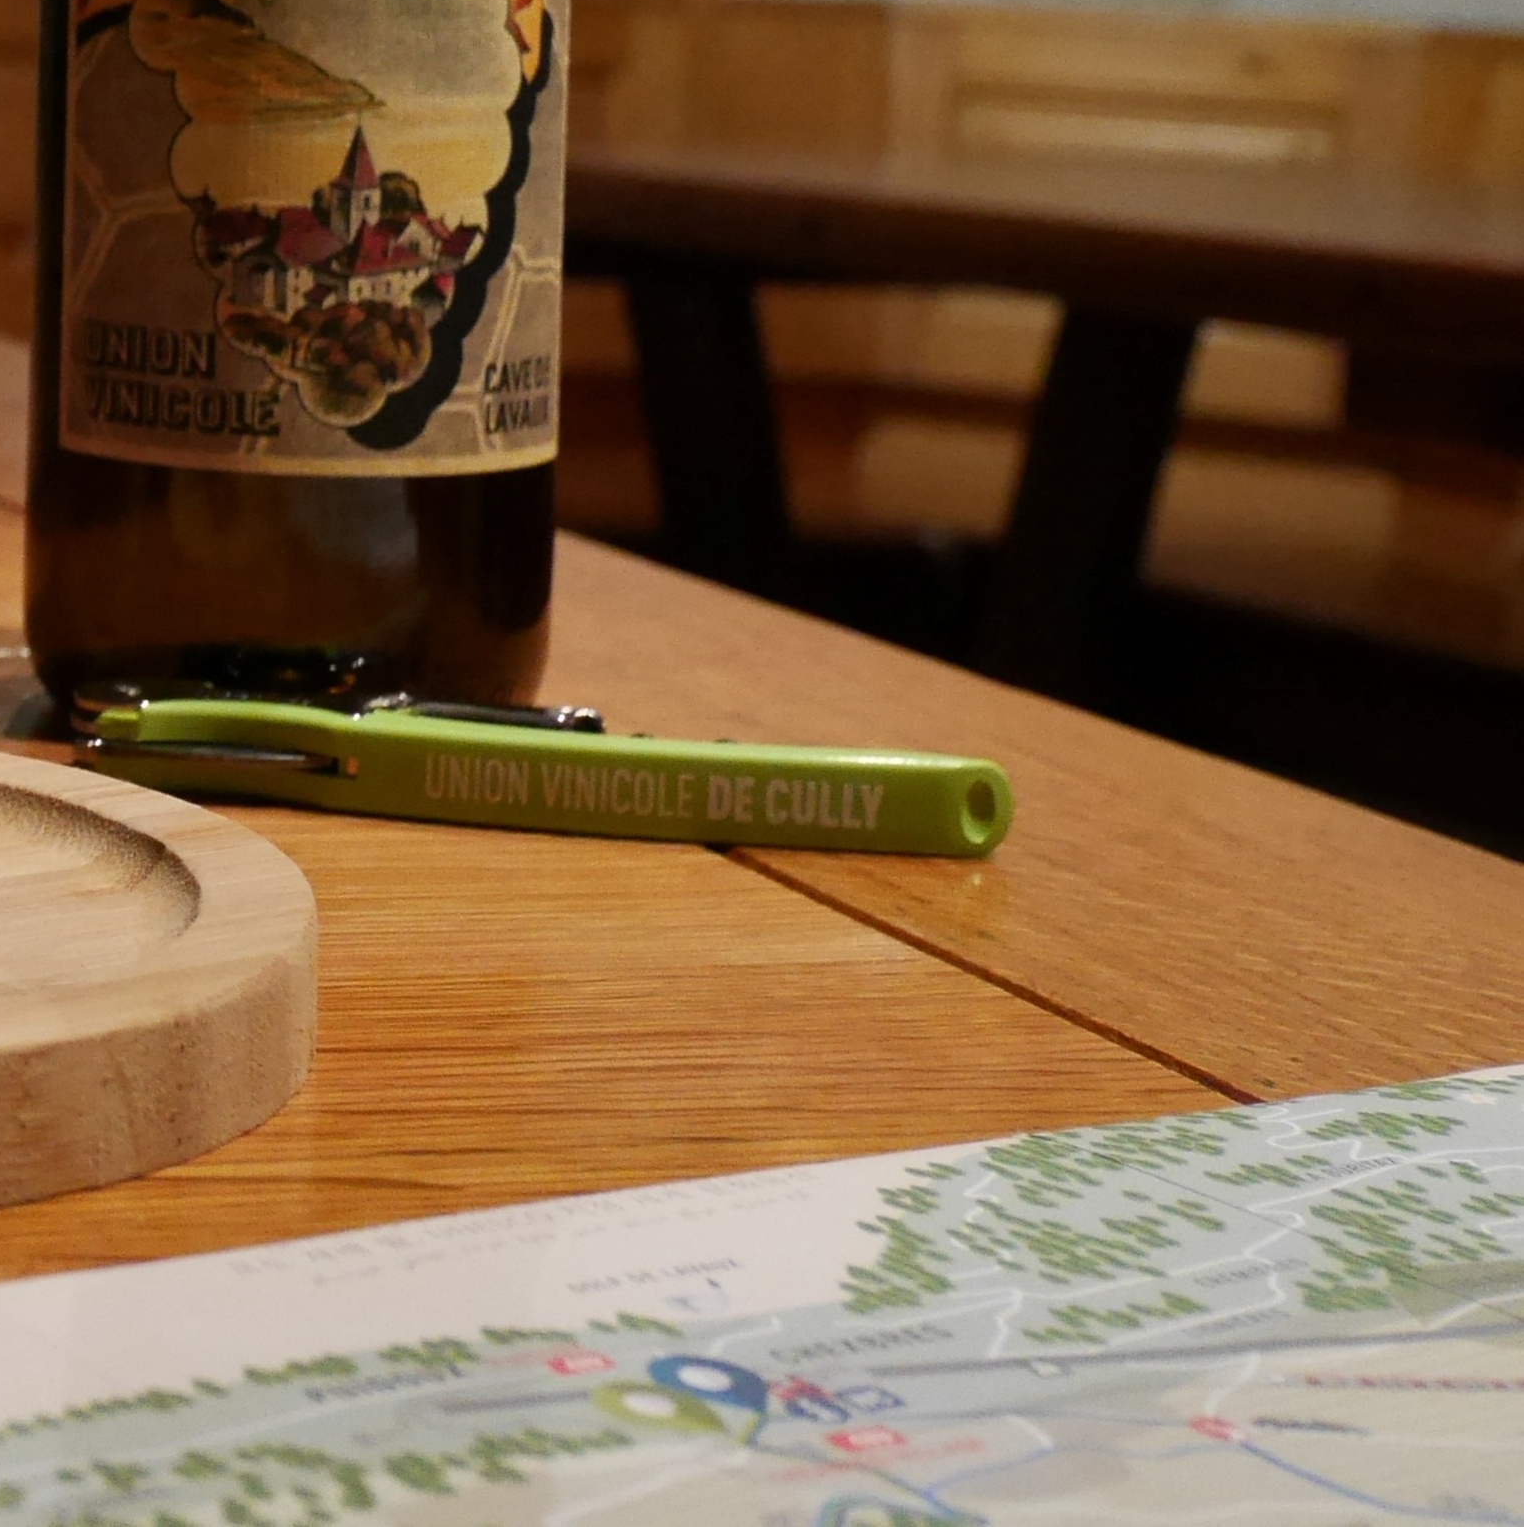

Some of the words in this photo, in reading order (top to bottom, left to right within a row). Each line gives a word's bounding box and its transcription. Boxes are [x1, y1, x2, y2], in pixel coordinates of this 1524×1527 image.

[86, 320, 216, 379] UNION
[85, 373, 281, 436] VINICOLE
[426, 753, 529, 806] UNION
[539, 762, 694, 819] VINICOLE
[706, 775, 754, 823] DE
[765, 779, 885, 831] CULLY
